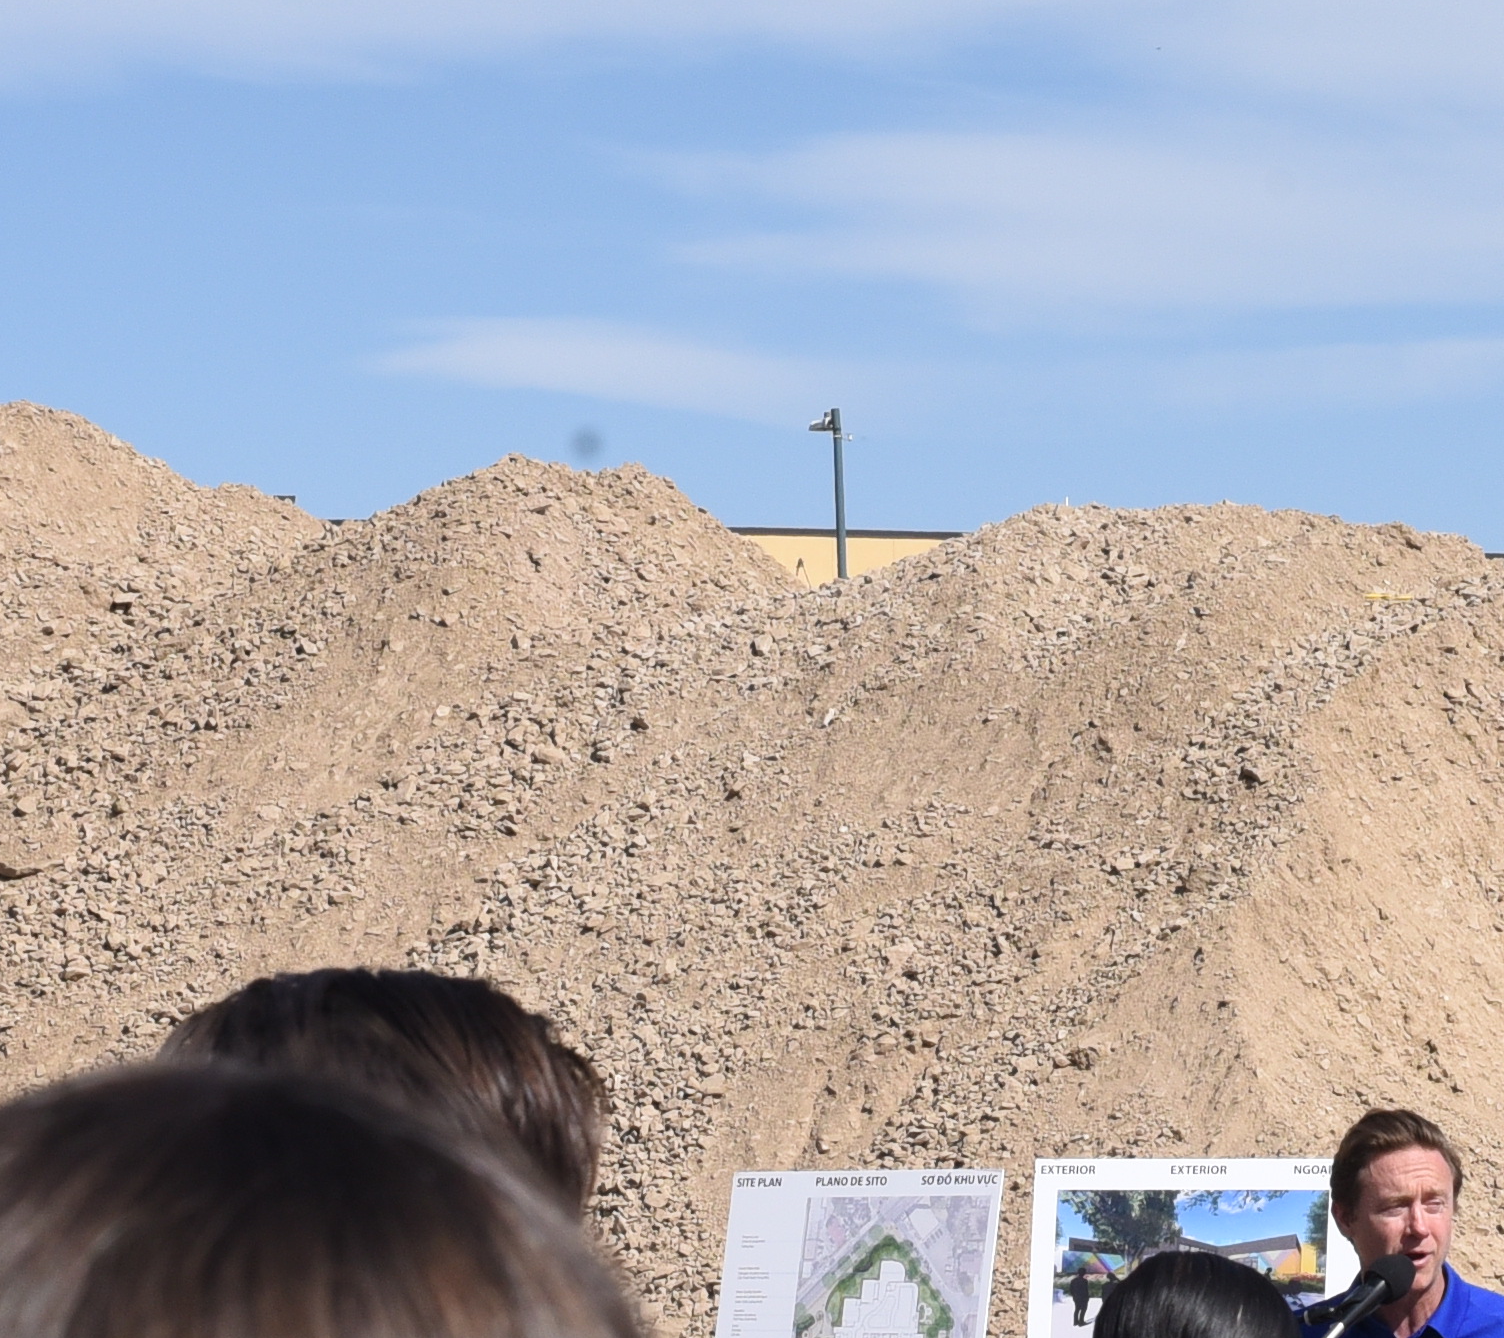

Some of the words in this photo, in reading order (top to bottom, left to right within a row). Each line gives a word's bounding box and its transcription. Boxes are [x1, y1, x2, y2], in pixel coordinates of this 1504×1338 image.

[1041, 1165, 1096, 1175] EXTERIOR
[1170, 1165, 1228, 1175] EXTERIOR
[736, 1177, 756, 1188] SITE
[757, 1177, 783, 1188] PLAN
[815, 1176, 848, 1187] PLANO
[849, 1176, 863, 1187] DE
[865, 1175, 888, 1187] SITO
[954, 1174, 975, 1185] KHU
